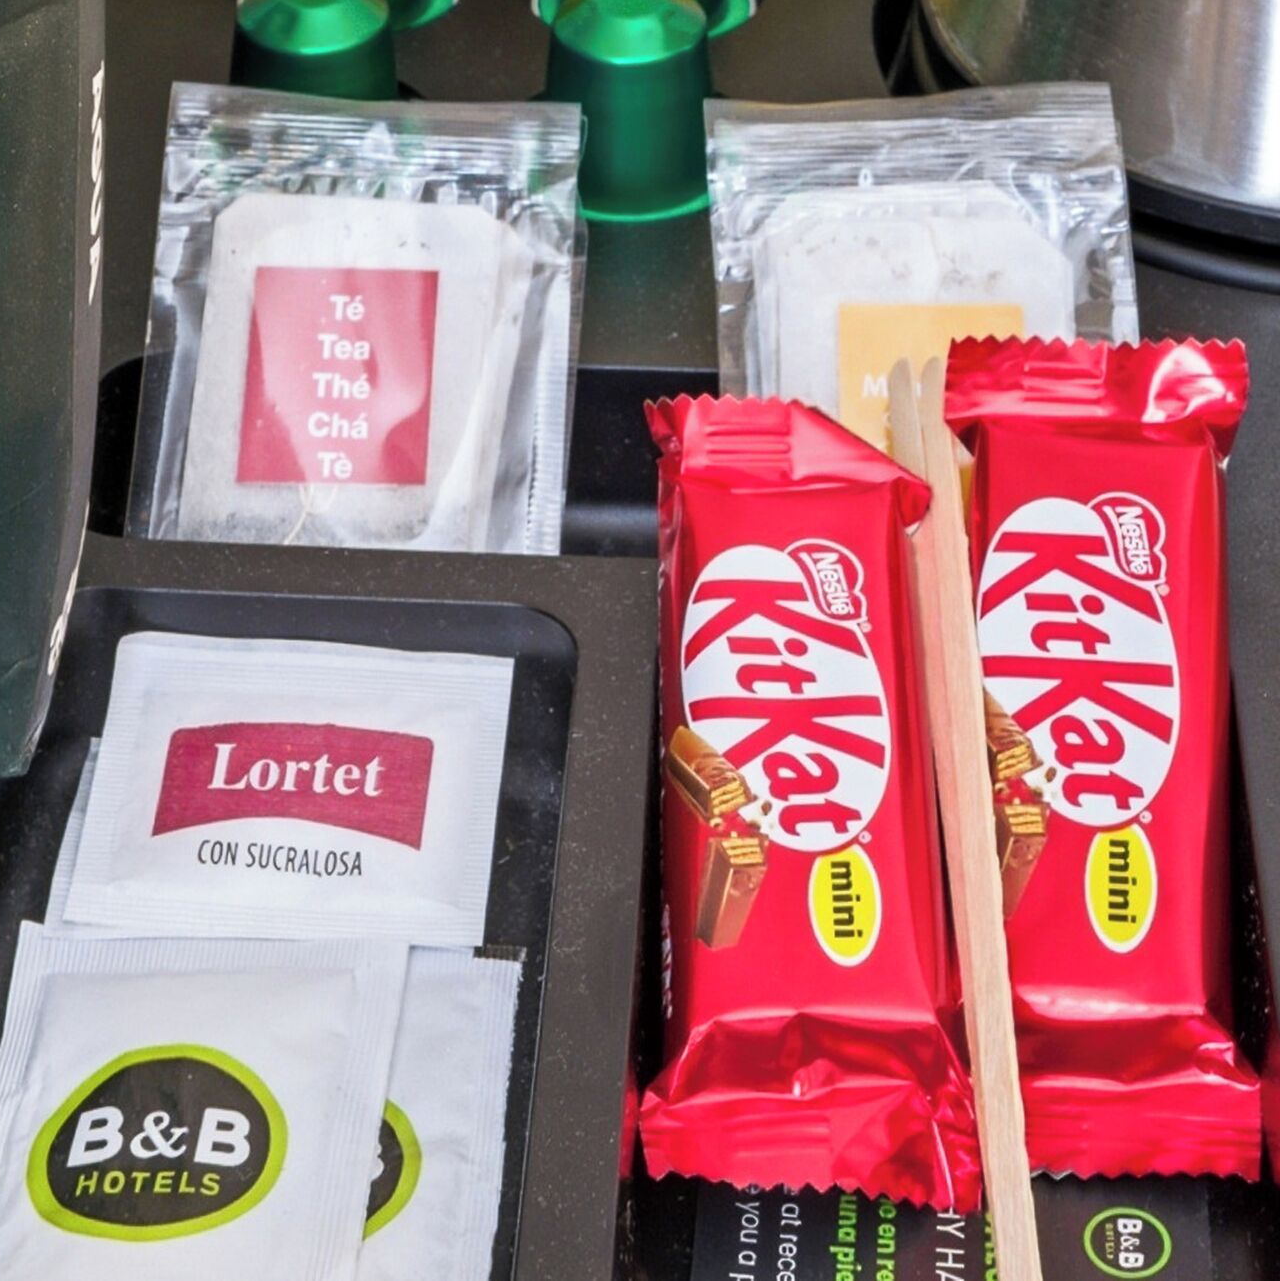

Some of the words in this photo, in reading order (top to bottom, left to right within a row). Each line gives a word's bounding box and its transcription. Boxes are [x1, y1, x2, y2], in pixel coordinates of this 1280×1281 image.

[329, 294, 366, 321] Té
[318, 333, 371, 361] Tea
[313, 371, 370, 400] Thé
[307, 410, 369, 440] Chá
[317, 451, 353, 480] Tè
[1115, 504, 1152, 577] Nestlé
[811, 549, 856, 617] Nestlé
[979, 530, 1178, 813] KitKat
[684, 576, 887, 839] KitKat
[207, 742, 386, 797] Lortet
[196, 838, 239, 868] CON
[244, 840, 364, 878] SUCRALOSA
[829, 859, 861, 940] mini
[1108, 837, 1137, 925] mini
[66, 1105, 252, 1168] B&B
[75, 1169, 221, 1197] HOTELS
[734, 1201, 761, 1244] you
[780, 1203, 803, 1226] at
[738, 1250, 758, 1266] a
[1116, 1217, 1145, 1269] B&B
